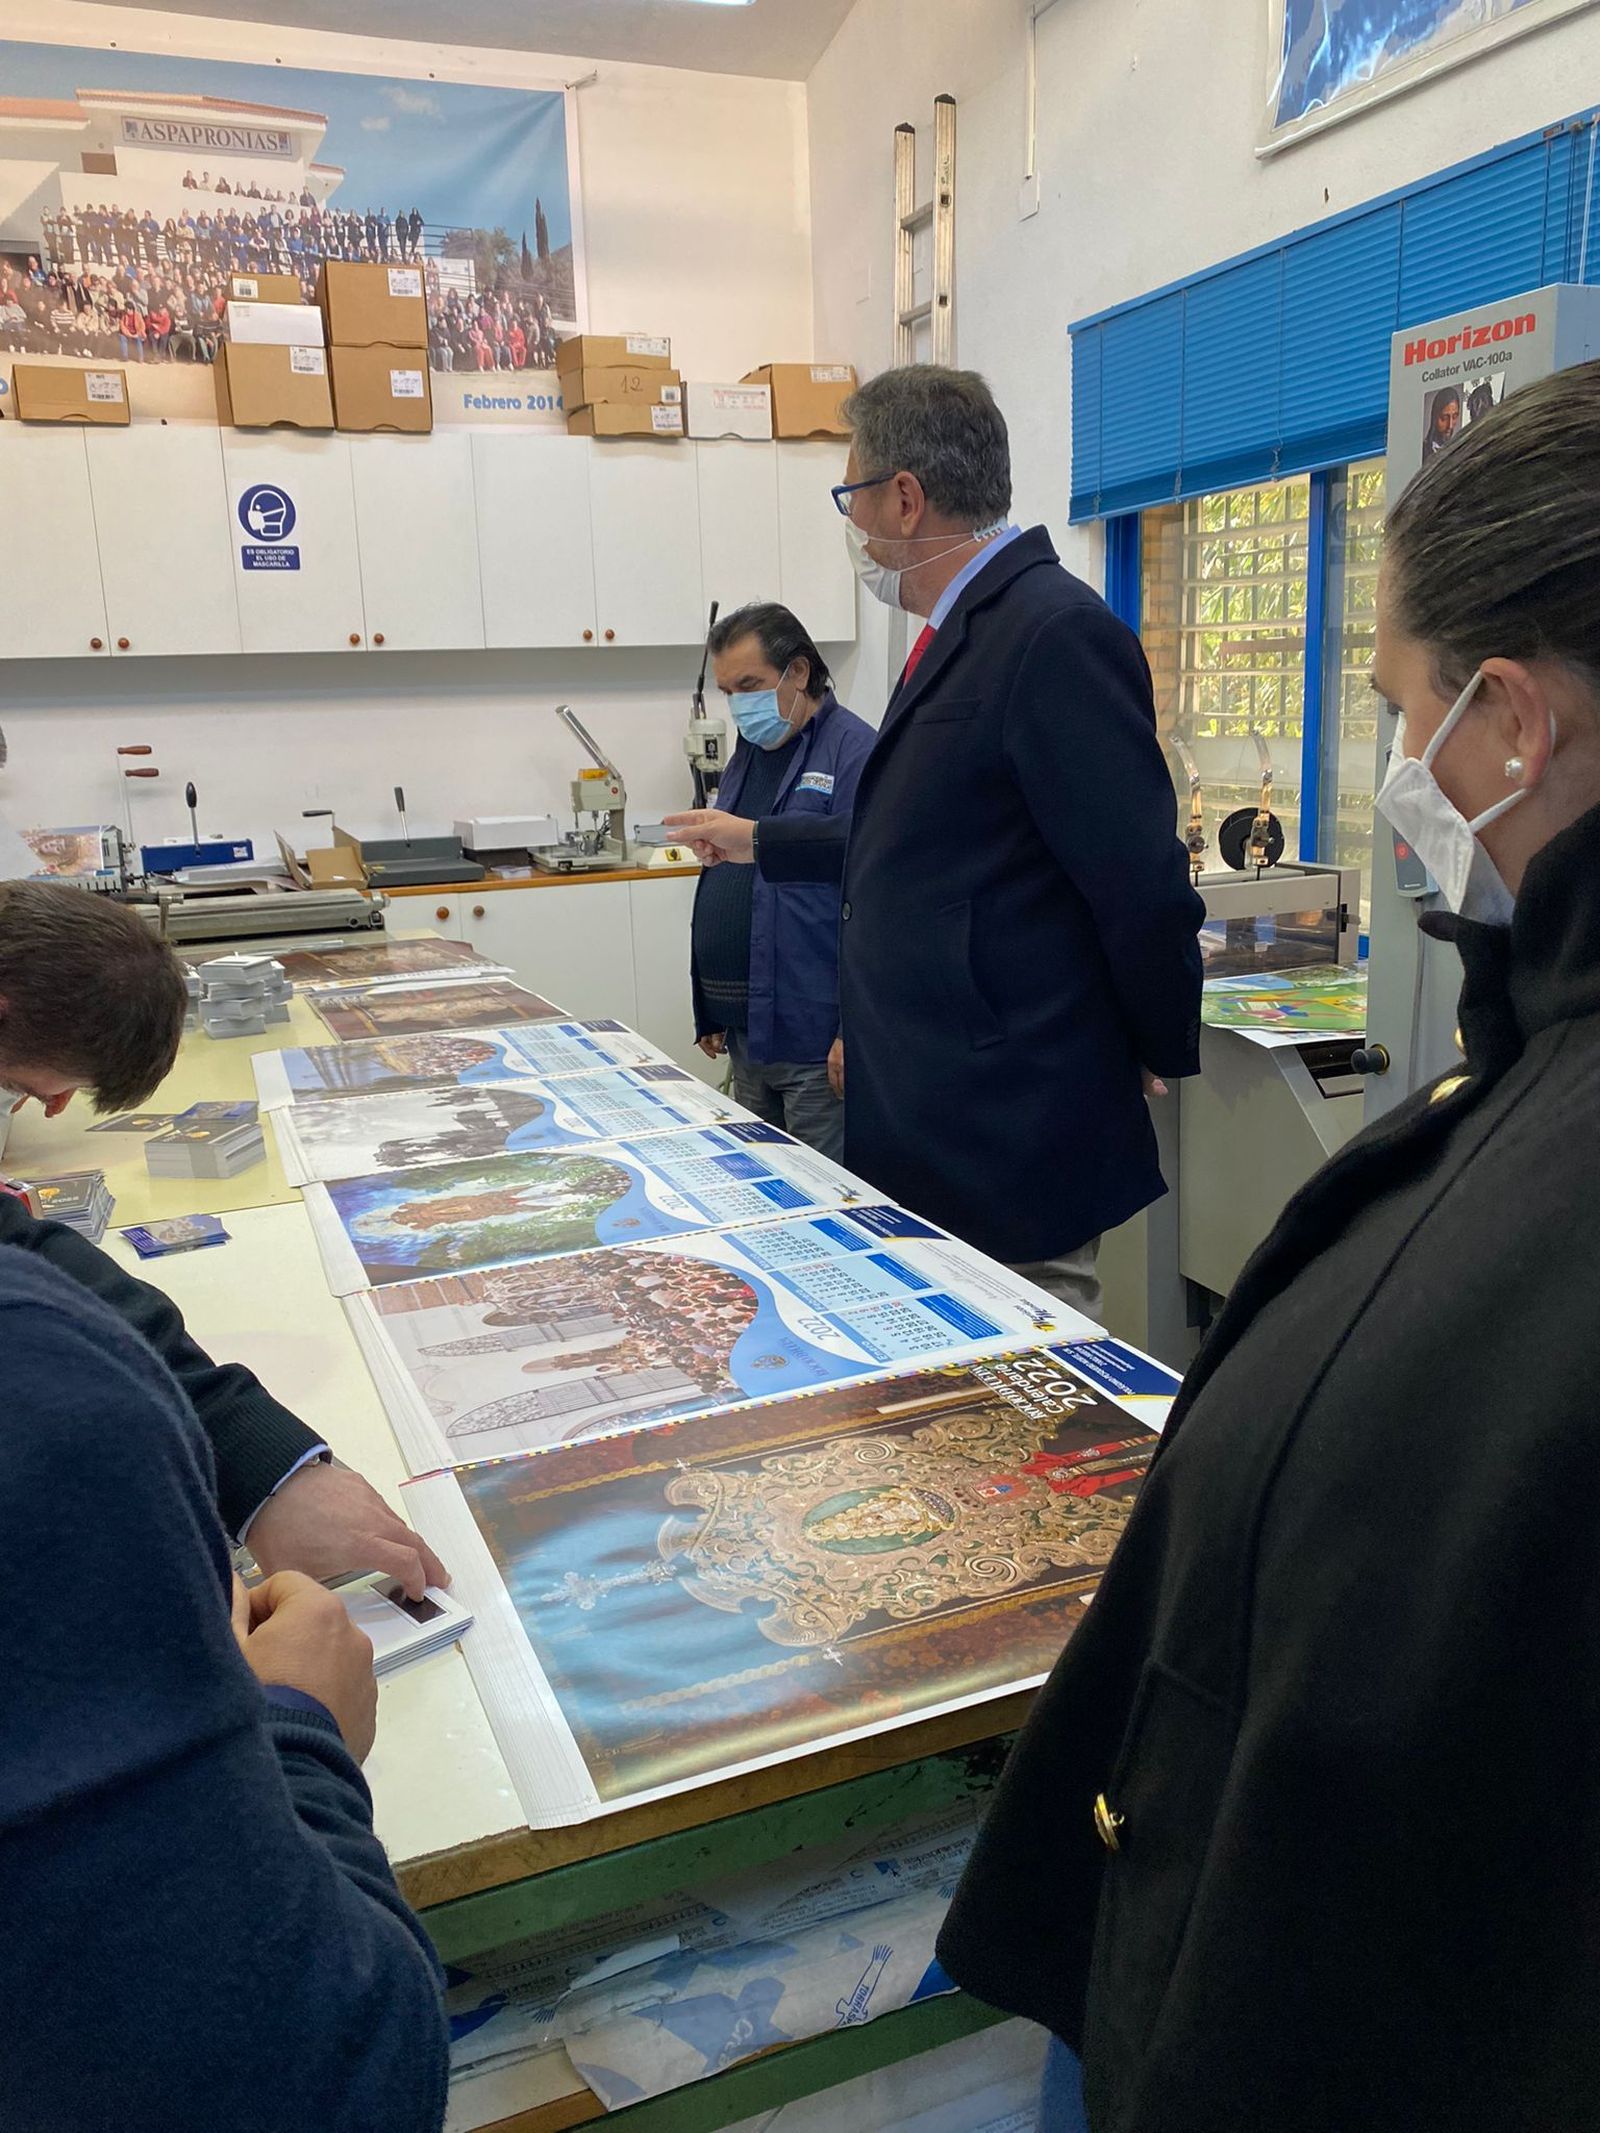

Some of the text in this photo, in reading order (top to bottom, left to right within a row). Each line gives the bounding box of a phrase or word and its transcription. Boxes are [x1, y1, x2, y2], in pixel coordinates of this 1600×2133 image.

[141, 122, 278, 150] ASPAPRONIAS
[1404, 312, 1536, 366] Horizon
[1422, 364, 1460, 382] Collator
[1462, 350, 1513, 372] VAC-100a
[620, 374, 644, 394] 12
[463, 394, 522, 410] Febrero
[797, 1316, 840, 1340] 2022
[862, 1340, 888, 1360] Enero
[996, 1364, 1064, 1414] Calendario
[1012, 1358, 1098, 1410] 2022
